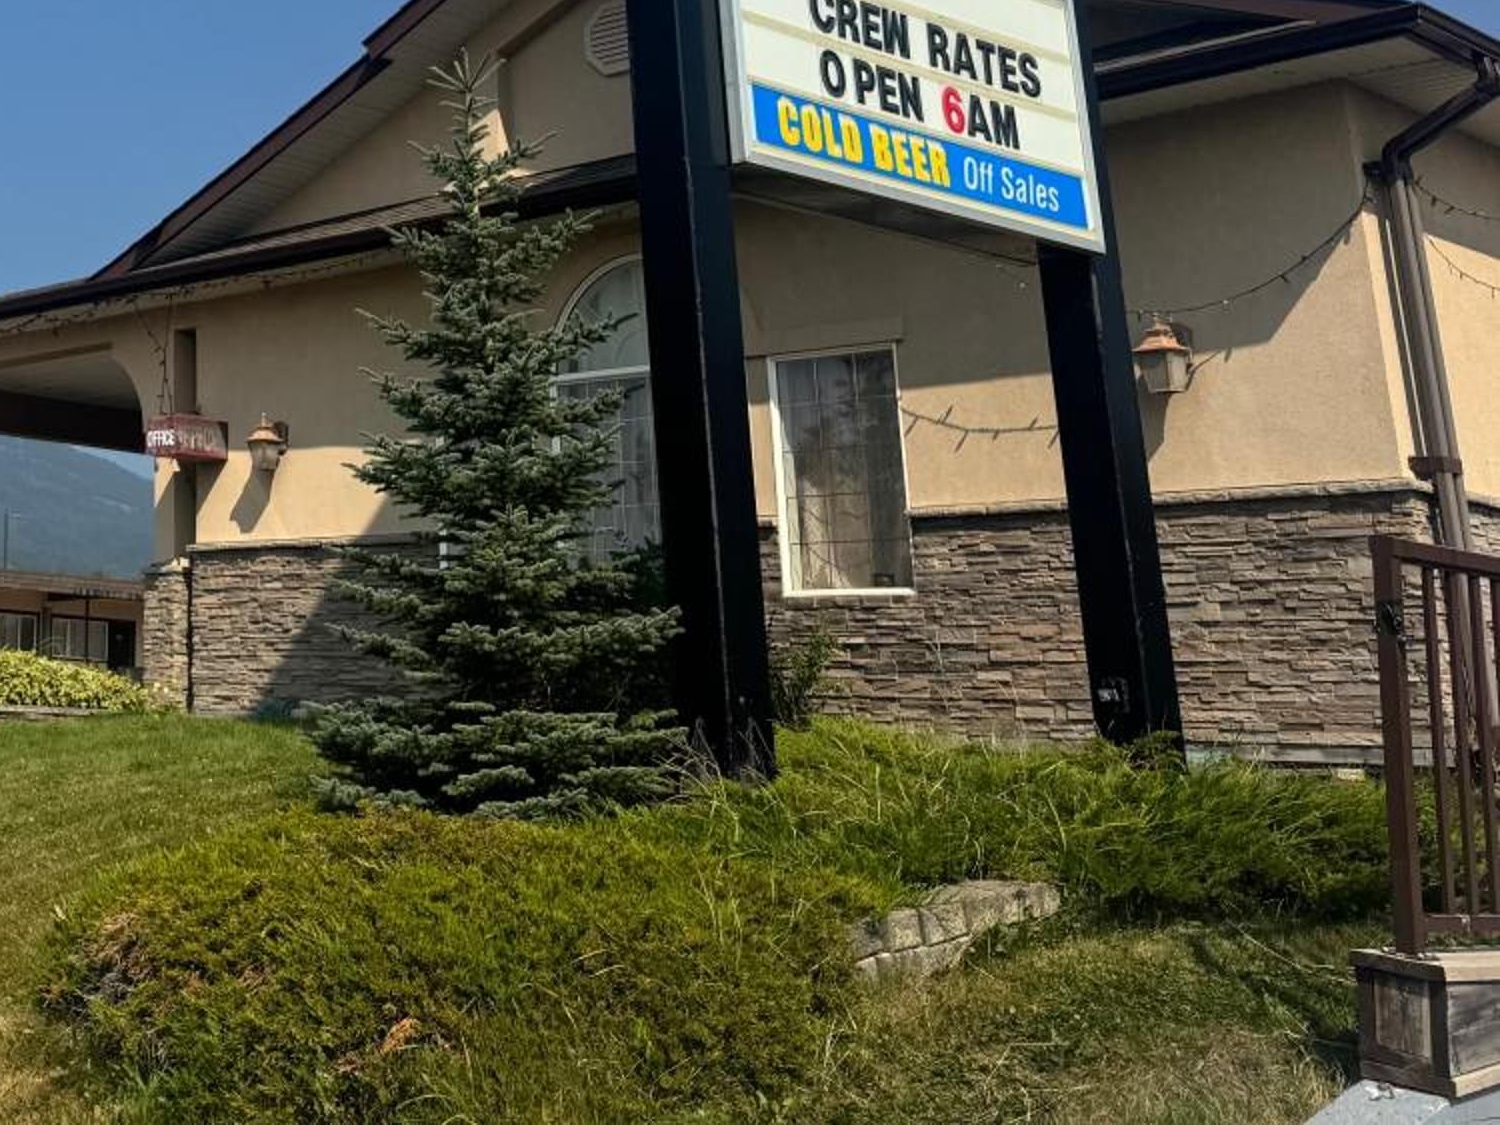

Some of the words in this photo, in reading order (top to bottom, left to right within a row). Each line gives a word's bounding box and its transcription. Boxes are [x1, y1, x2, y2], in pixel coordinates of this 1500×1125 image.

[819, 49, 925, 123] OPEN
[940, 86, 1020, 150] 6AM
[926, 22, 1042, 98] RATES
[777, 96, 863, 164] COLD
[871, 124, 952, 188] BEER
[963, 156, 994, 196] Off
[1001, 169, 1060, 213] Sales
